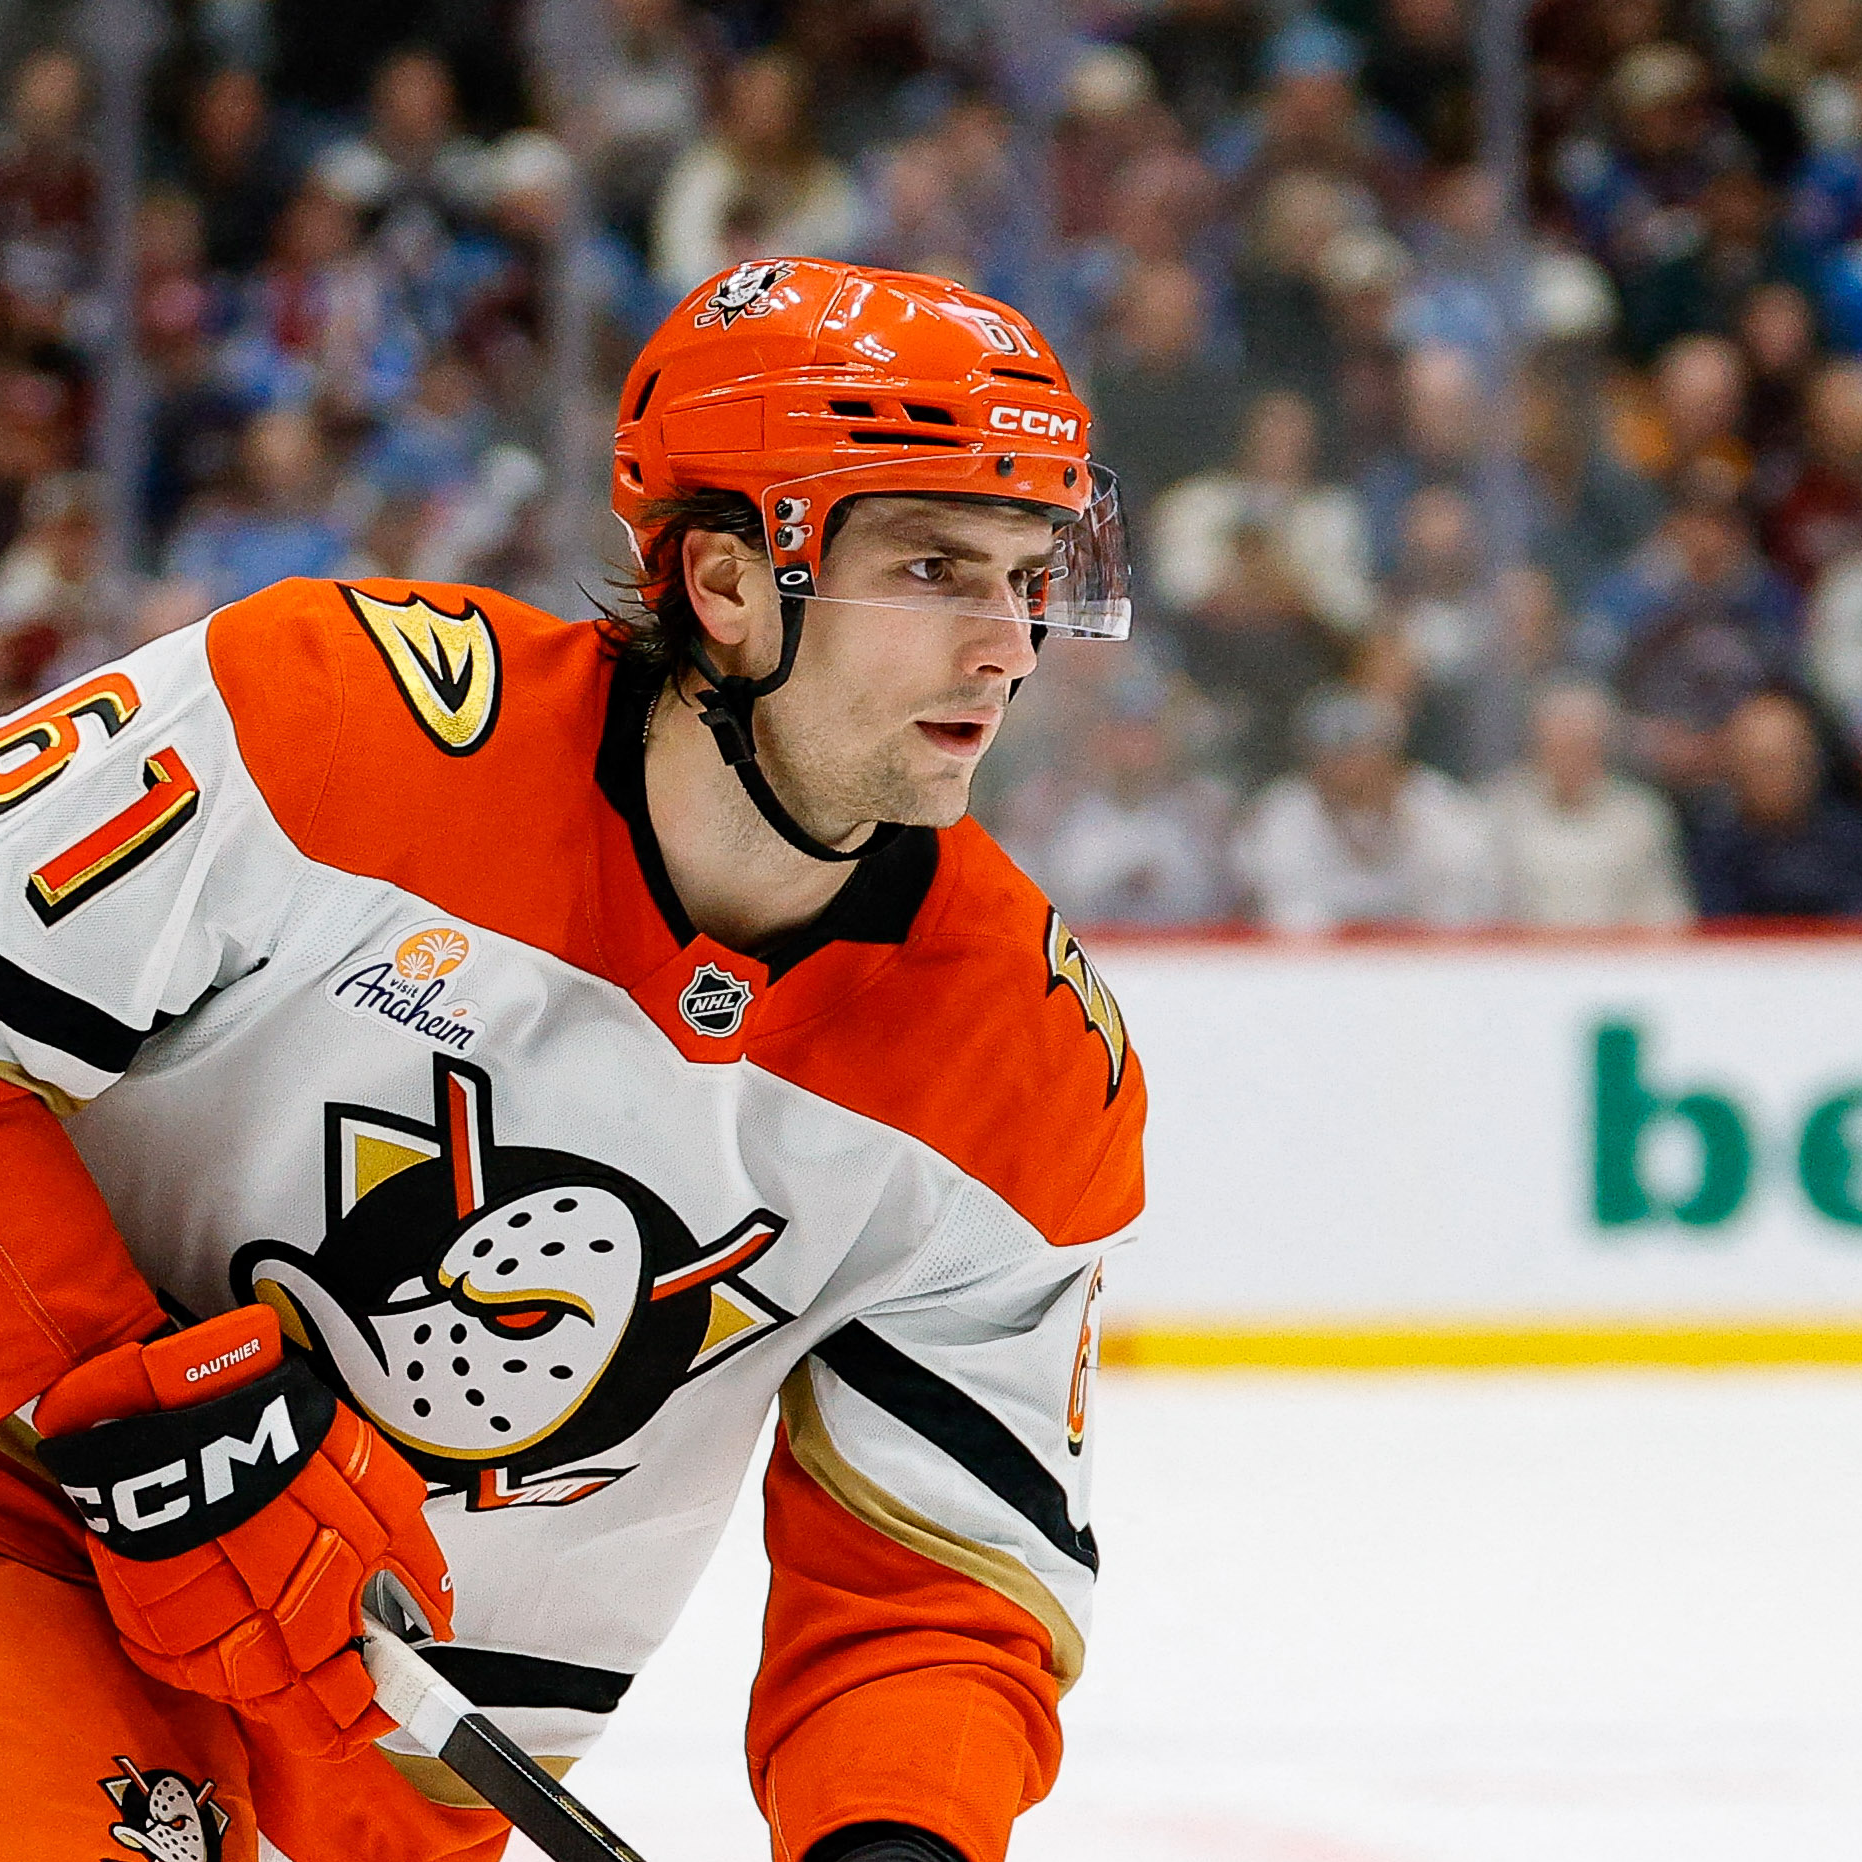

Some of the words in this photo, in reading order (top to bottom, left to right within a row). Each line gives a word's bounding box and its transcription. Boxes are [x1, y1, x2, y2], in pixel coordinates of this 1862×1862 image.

[989, 405, 1078, 442] CCM
[333, 961, 476, 1051] Anaheim
[389, 976, 421, 999] visit
[690, 992, 738, 1014] NHL
[185, 1338, 262, 1383] GAUTHIER
[60, 1394, 301, 1535] CCM
